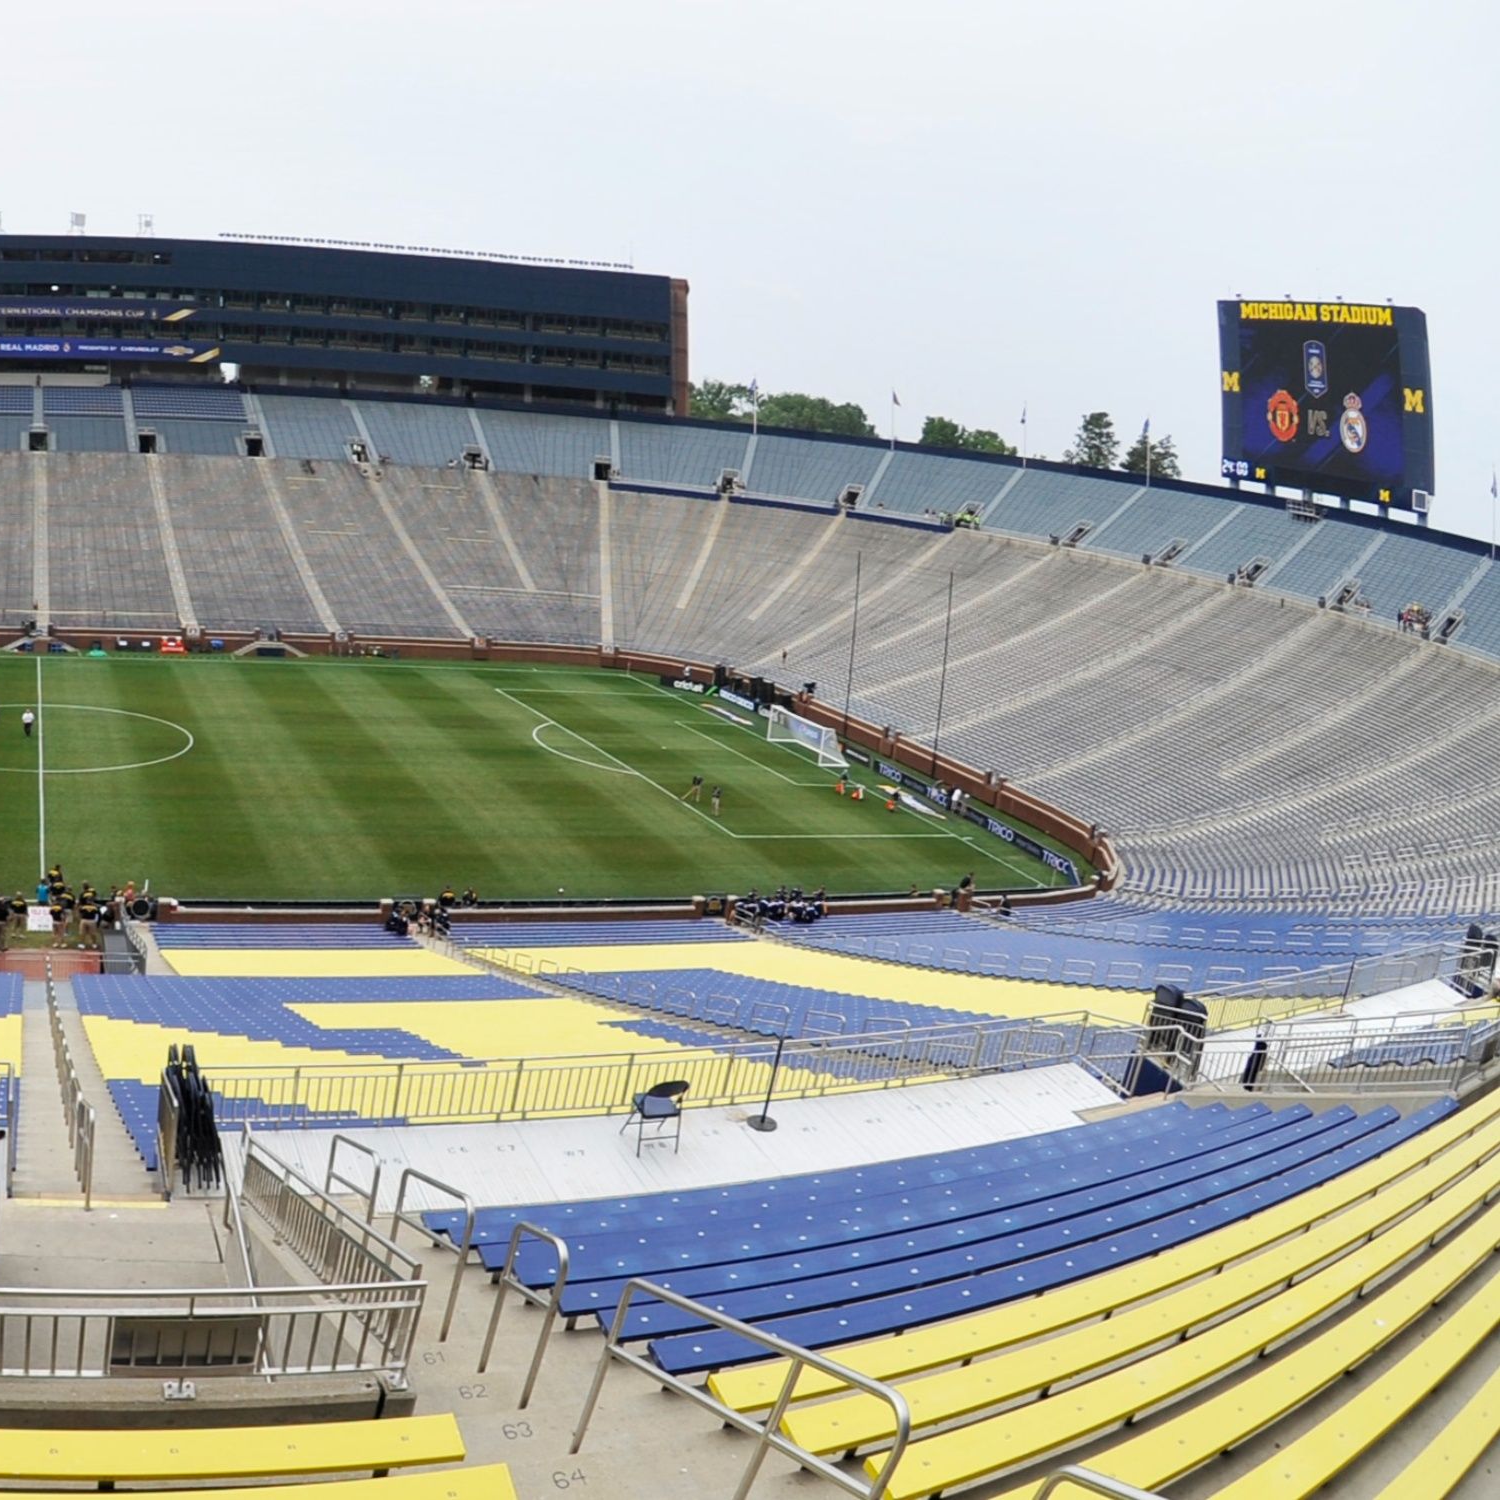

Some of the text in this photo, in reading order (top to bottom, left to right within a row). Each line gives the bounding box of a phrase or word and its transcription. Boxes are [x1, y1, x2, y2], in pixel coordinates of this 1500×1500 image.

[65, 307, 123, 318] CHAMPIONS
[125, 308, 145, 318] CUP
[1240, 302, 1393, 326] MICHIGAN STADIUM
[0, 343, 21, 352] REAL
[24, 343, 60, 353] MADRID
[1222, 370, 1241, 393] M
[1402, 387, 1425, 414] M
[1306, 408, 1331, 437] VS.
[1222, 458, 1249, 477] 24:00
[878, 762, 902, 783] TRICO
[987, 818, 1015, 842] TRICO
[422, 1351, 446, 1366] 61
[458, 1383, 489, 1400] 62
[501, 1421, 533, 1440] 63
[552, 1467, 587, 1490] 64
